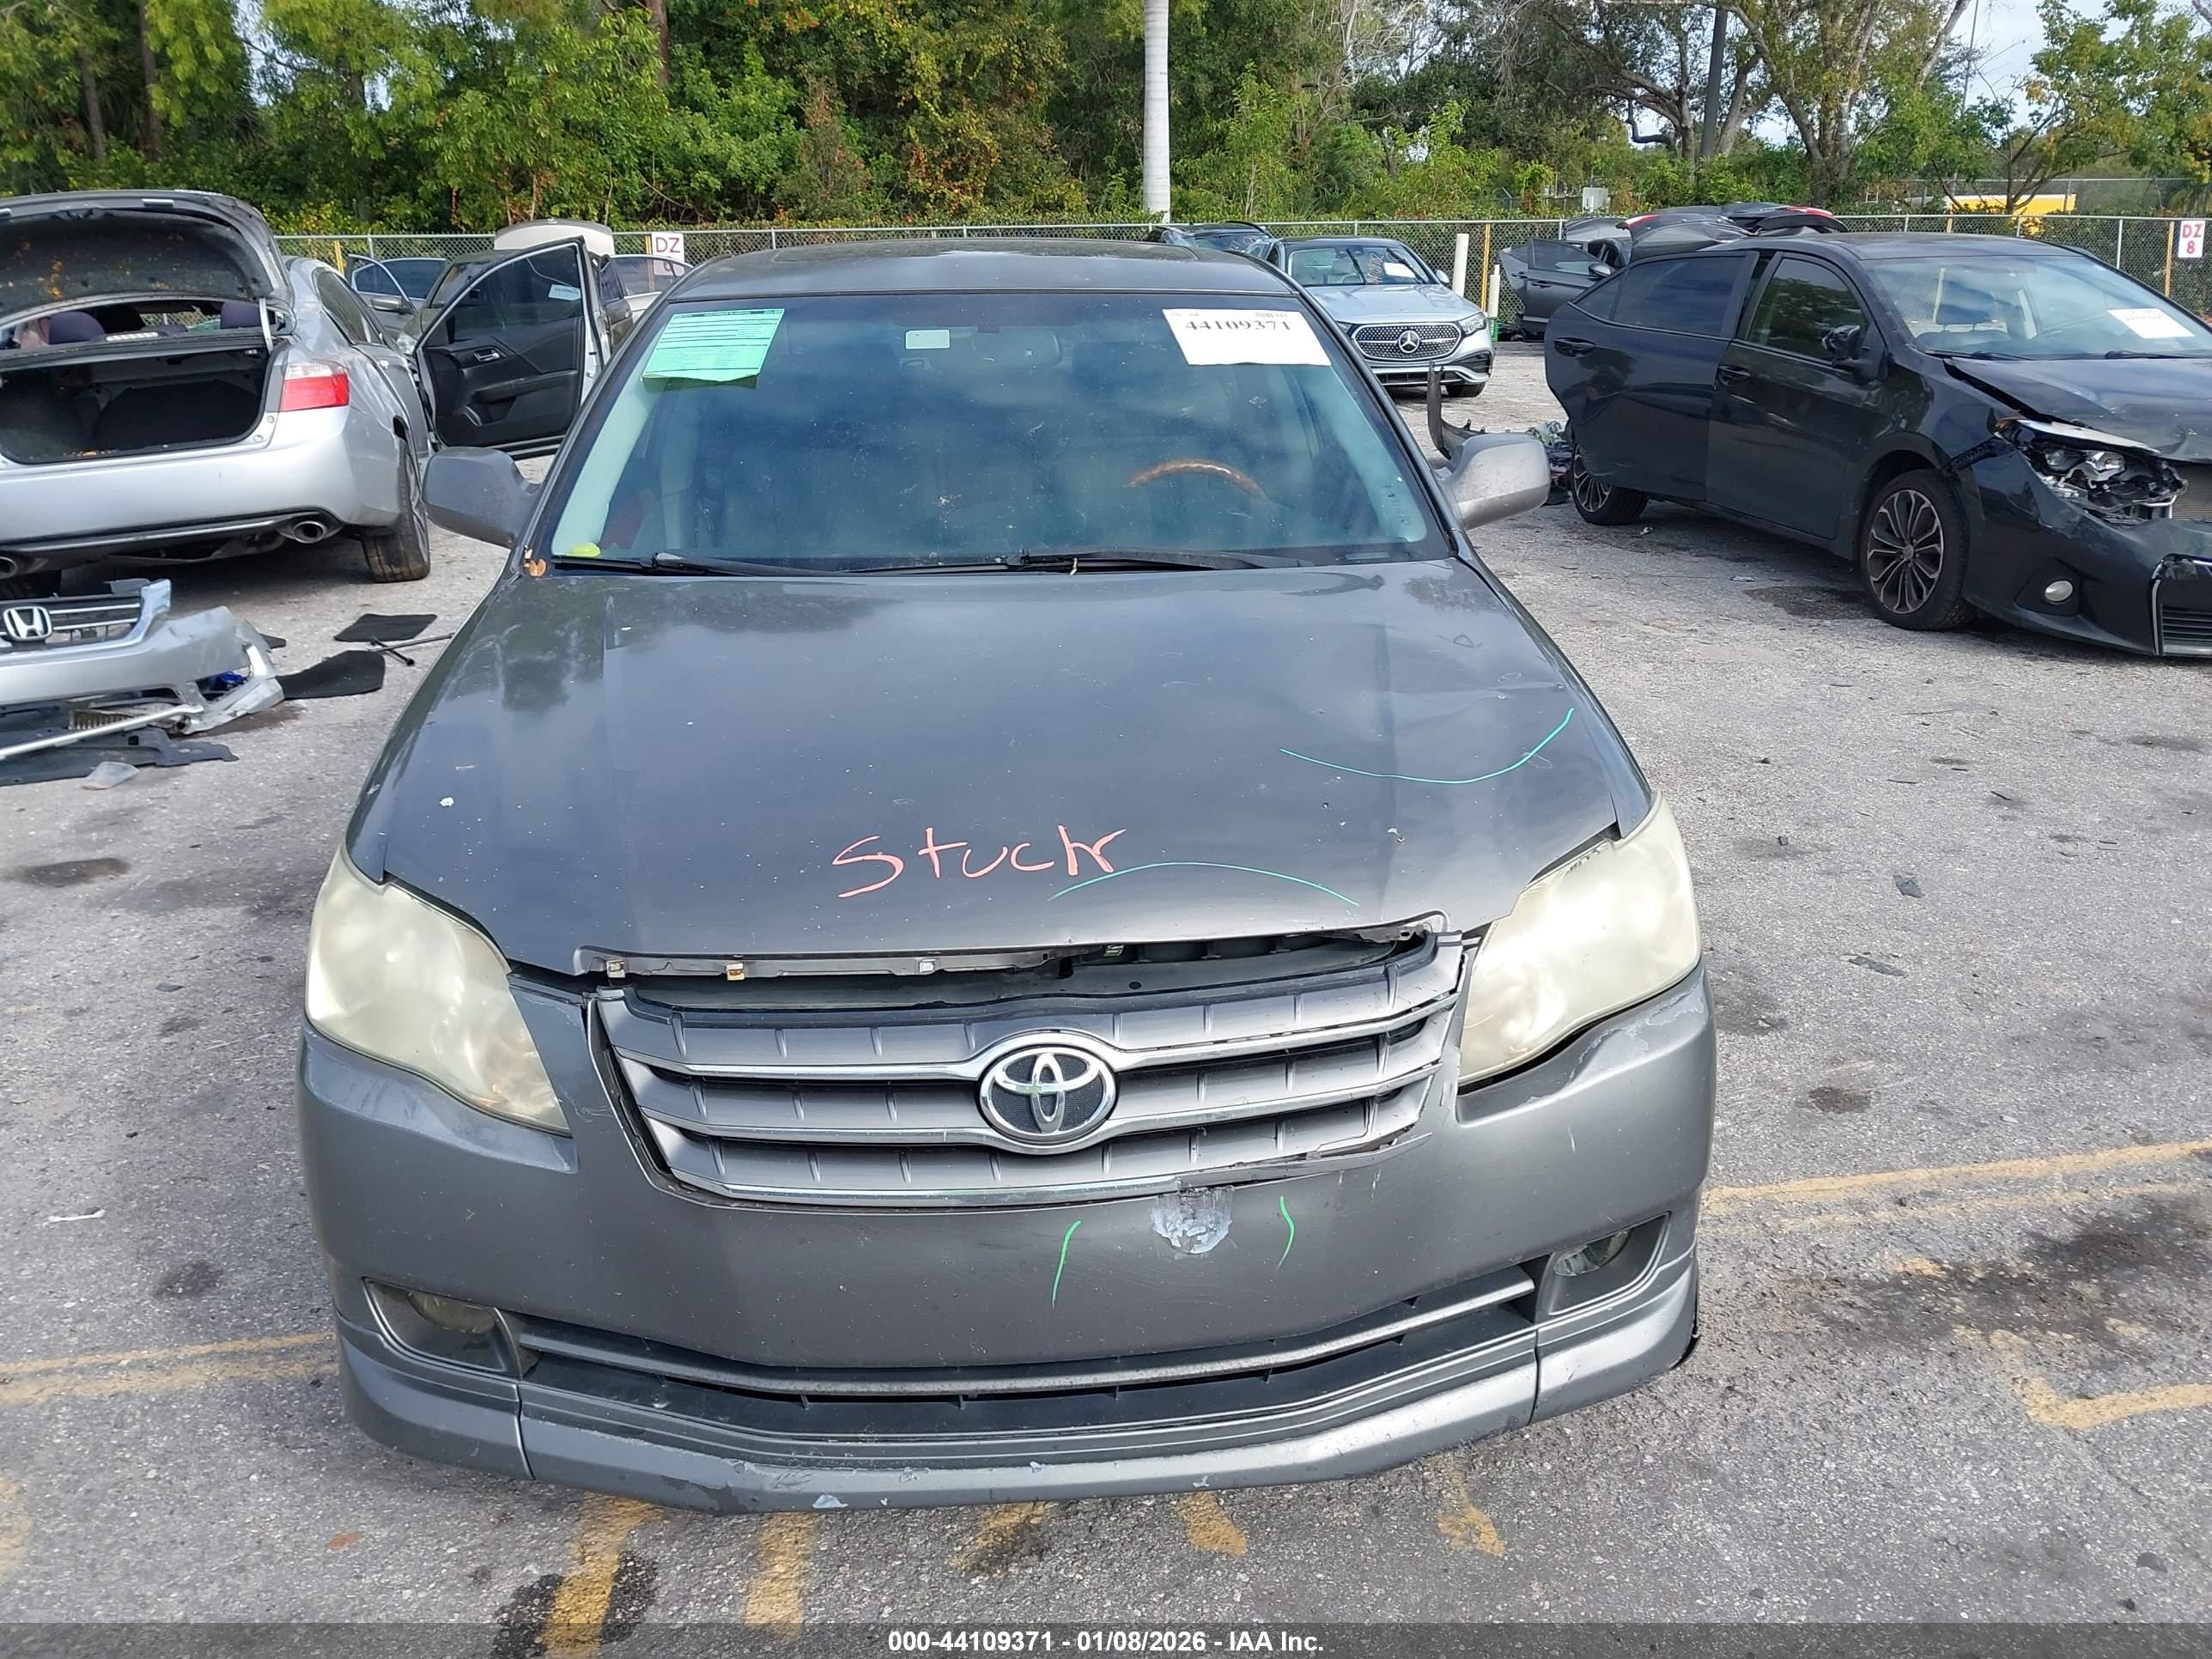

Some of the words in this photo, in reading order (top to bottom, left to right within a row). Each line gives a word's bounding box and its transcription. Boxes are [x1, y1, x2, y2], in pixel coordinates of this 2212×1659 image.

[2182, 223, 2203, 238] DZ
[655, 237, 681, 253] DZ
[2186, 240, 2196, 254] 8
[1185, 319, 1291, 331] 44109371
